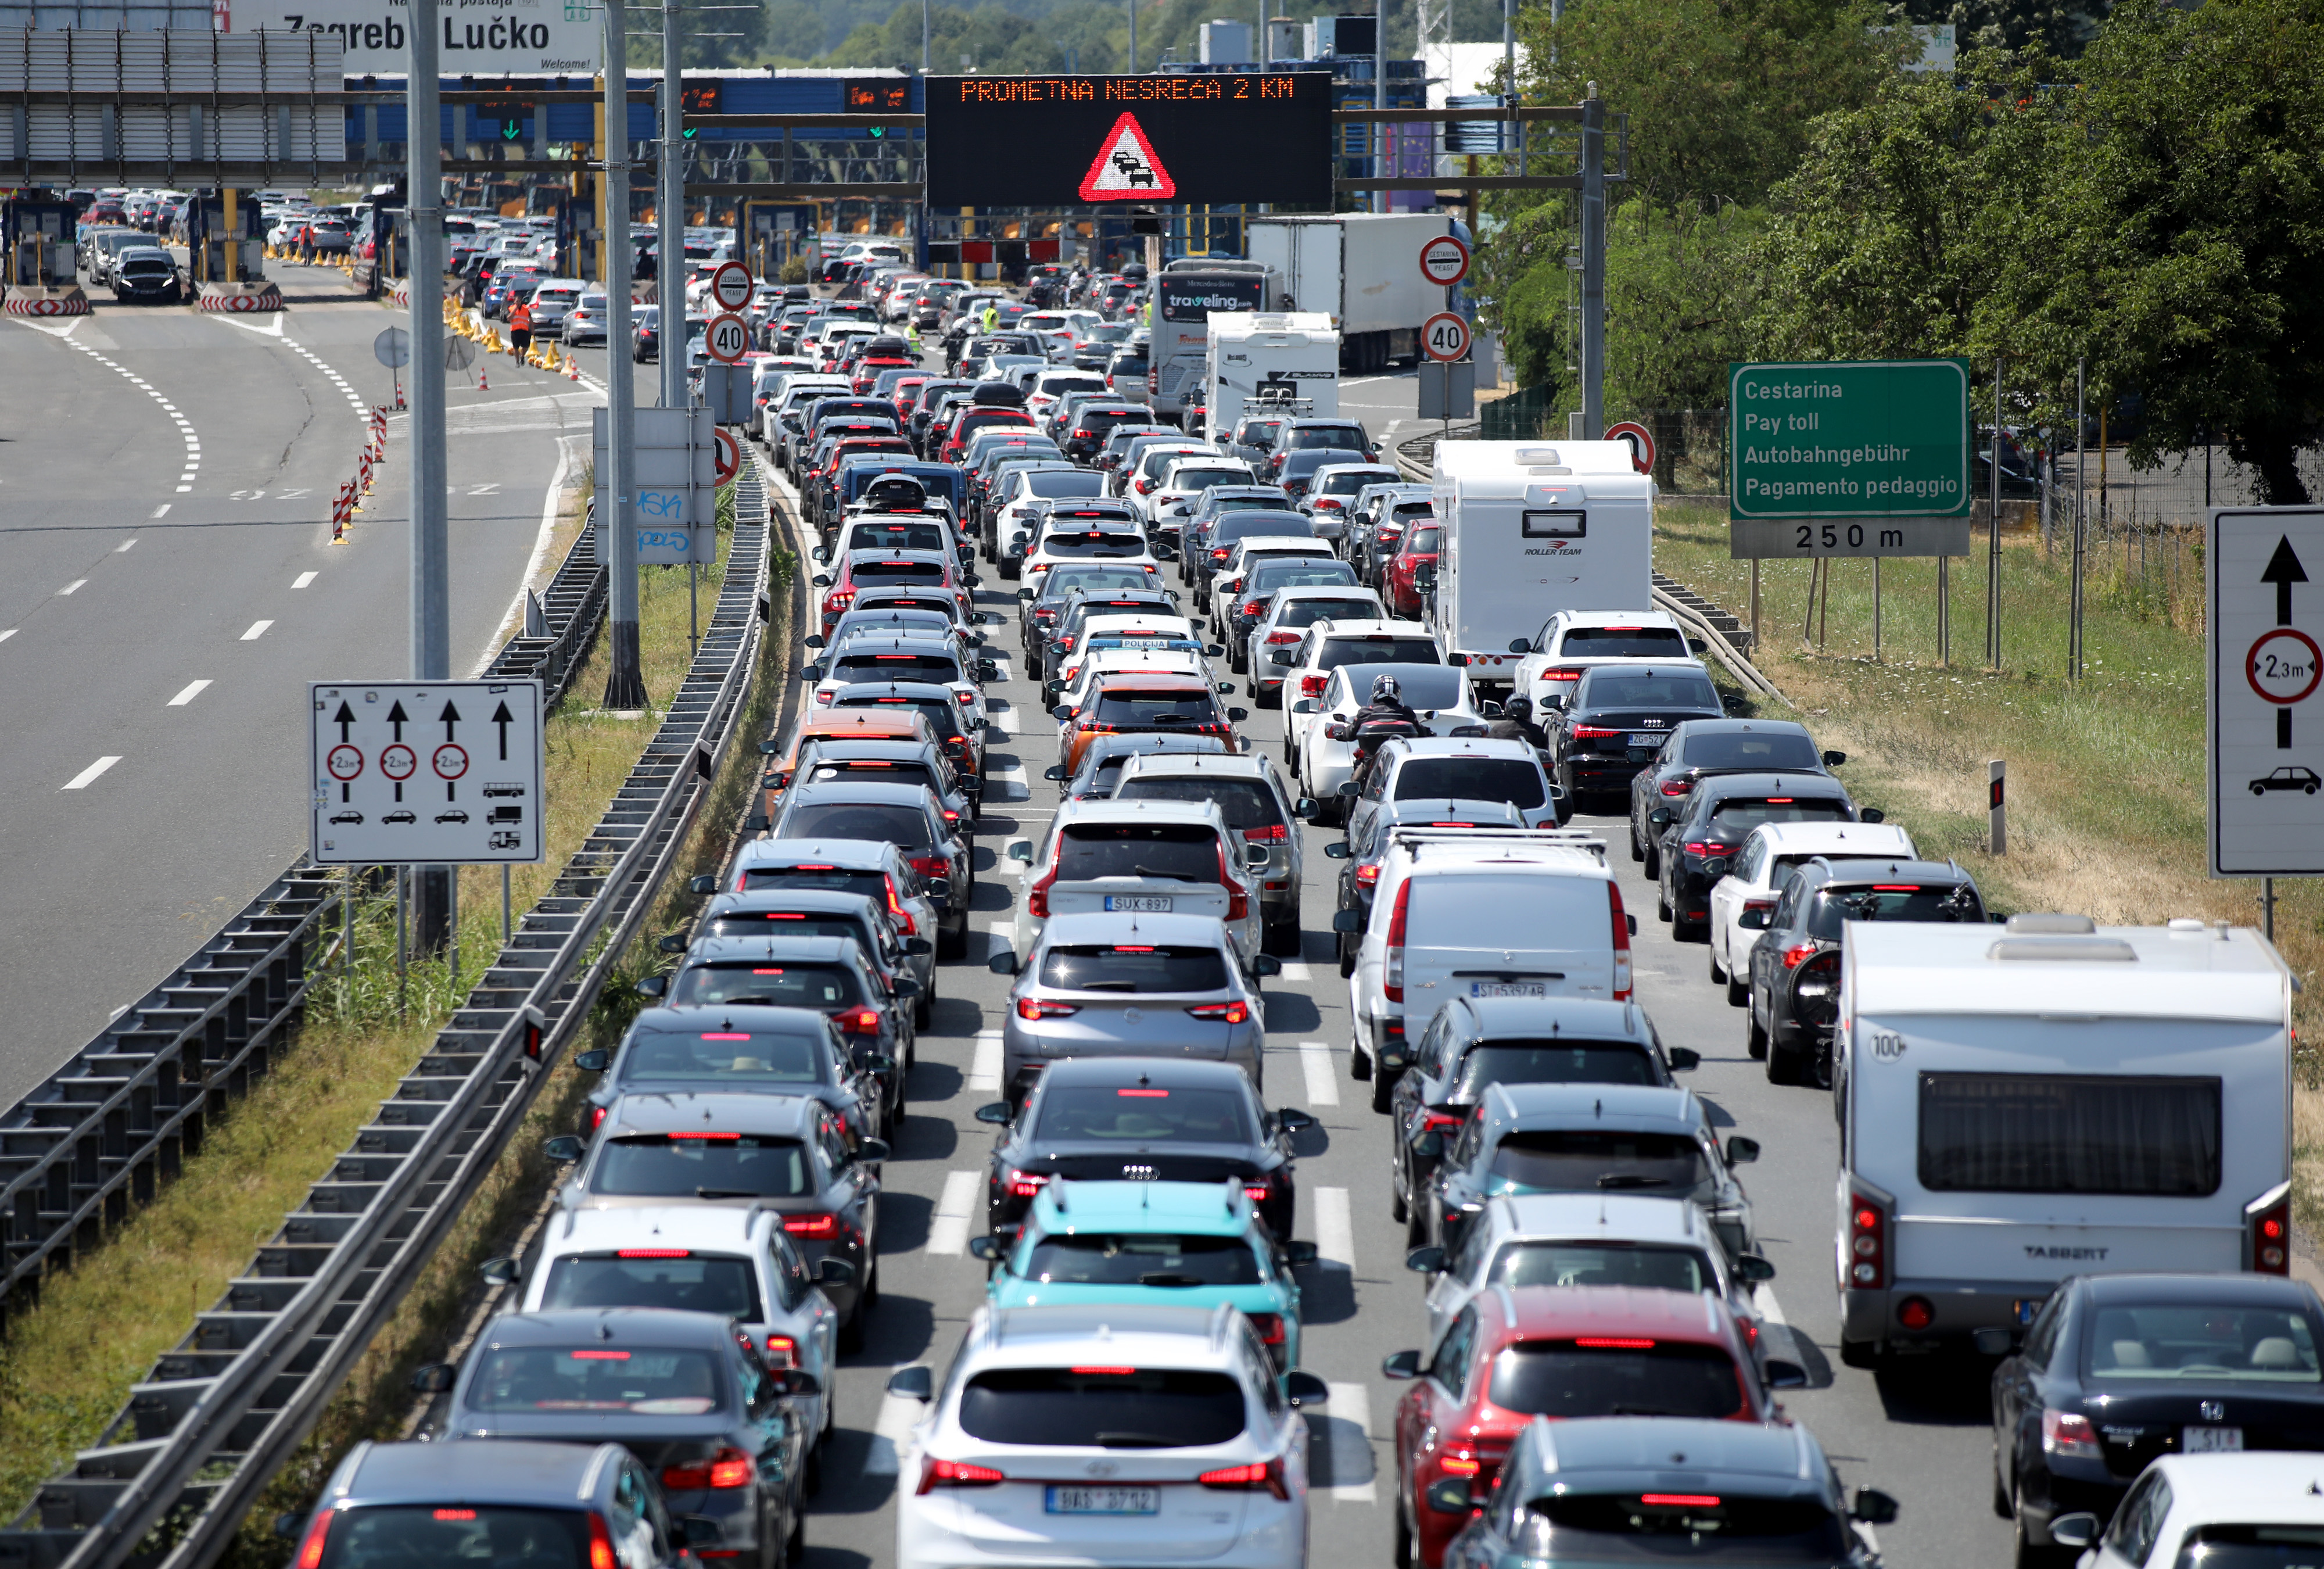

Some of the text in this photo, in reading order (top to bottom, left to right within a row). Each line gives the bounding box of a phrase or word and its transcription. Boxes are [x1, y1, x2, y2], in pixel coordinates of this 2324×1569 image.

[444, 16, 549, 49] Lučko
[541, 59, 590, 69] Welcome!
[962, 80, 1093, 101] PROMETNA
[1234, 78, 1249, 99] 2
[1261, 78, 1293, 98] KM
[717, 327, 740, 350] 40
[1432, 327, 1459, 349] 40
[1745, 381, 1842, 400] Cestarina
[1746, 413, 1819, 435] Pay toll
[1745, 445, 1910, 467] Autobahngebühr
[1746, 475, 1957, 500] Pagamento pedaggio
[1796, 524, 1903, 548] 250 m
[1634, 735, 1666, 744] ZG 521
[1115, 898, 1168, 911] SUX-897
[1874, 1036, 1902, 1057] 100
[2024, 1245, 2110, 1260] TABBERT
